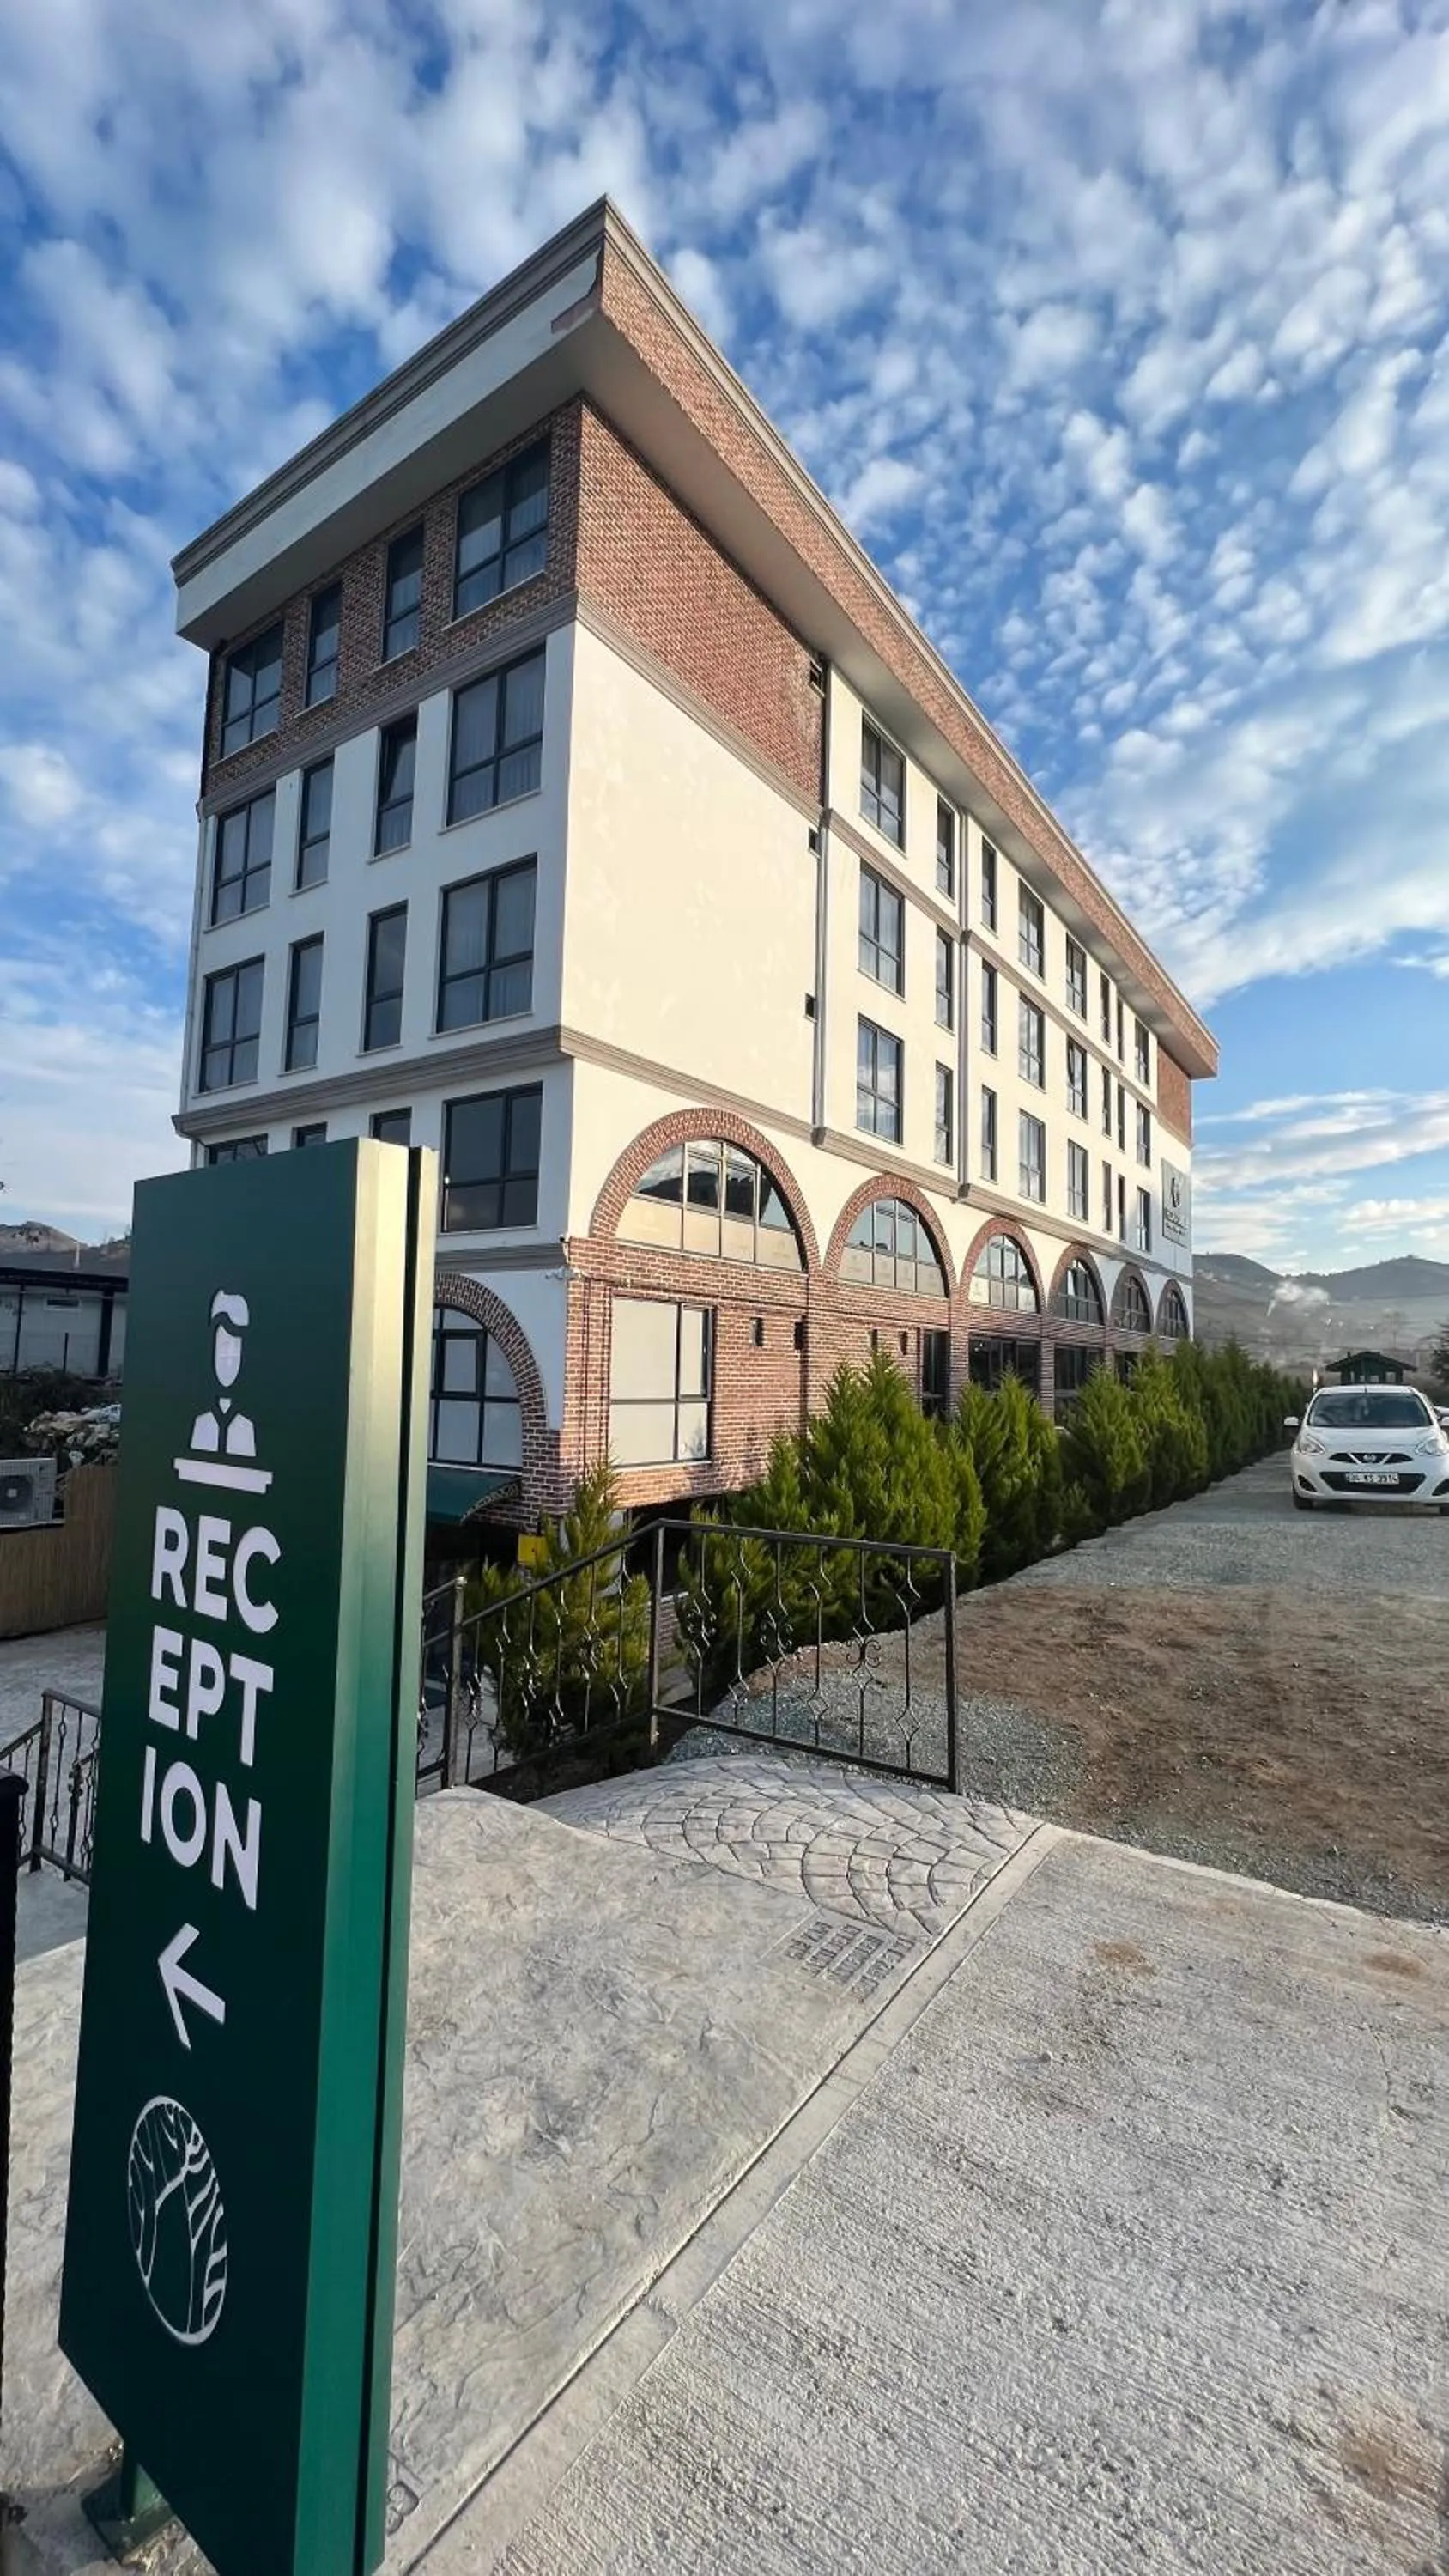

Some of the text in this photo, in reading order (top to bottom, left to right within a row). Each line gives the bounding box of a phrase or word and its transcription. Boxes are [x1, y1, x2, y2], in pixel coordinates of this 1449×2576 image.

[151, 1505, 281, 1633] REC
[149, 1625, 274, 1767] EPT
[141, 1745, 262, 1911] ION
